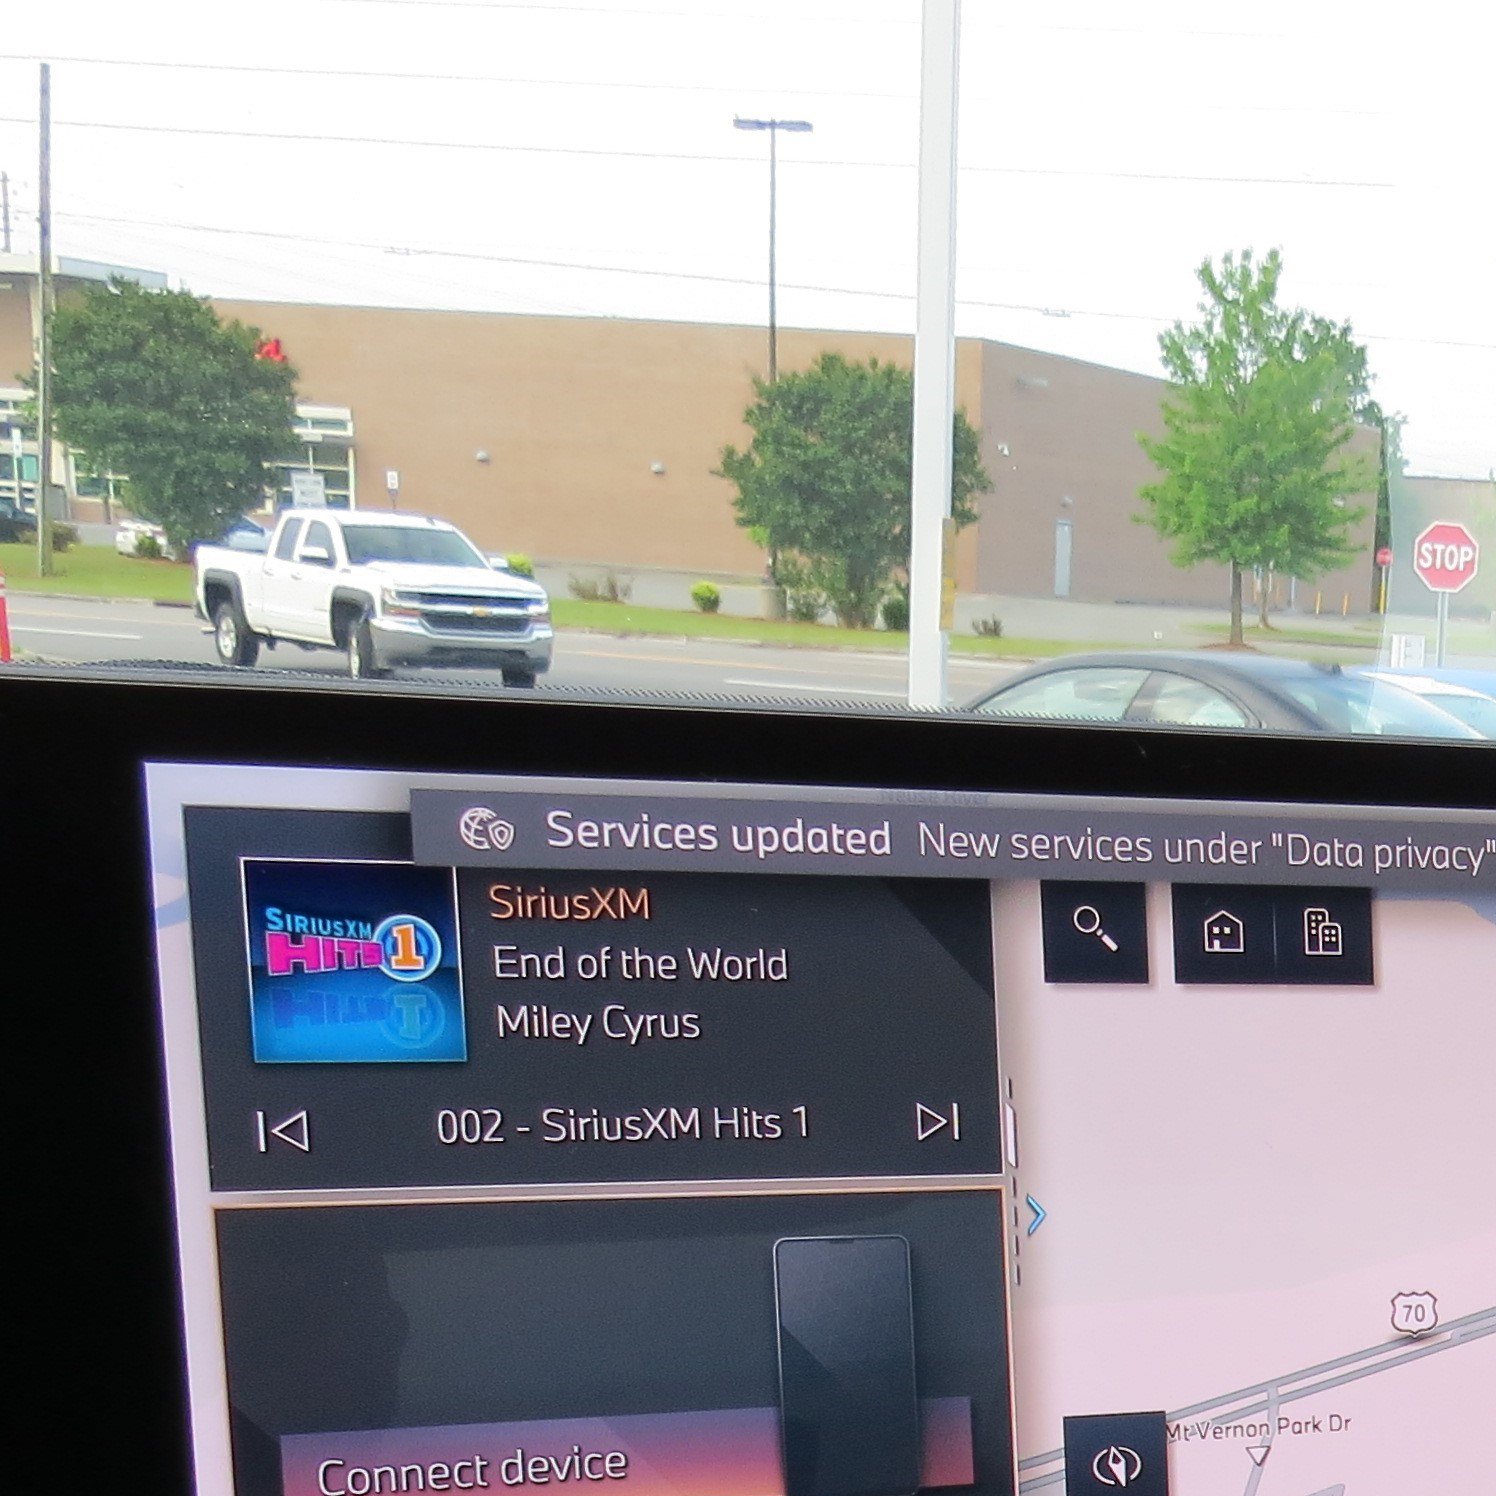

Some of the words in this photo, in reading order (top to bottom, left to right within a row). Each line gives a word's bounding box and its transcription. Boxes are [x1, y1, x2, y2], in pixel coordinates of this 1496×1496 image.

[1419, 542, 1473, 571] STOP
[547, 809, 718, 852] Services
[731, 820, 892, 860] updated
[919, 821, 1000, 860] New
[1010, 826, 1153, 863] services
[1164, 830, 1263, 867] under
[1272, 832, 1365, 868] "Data
[488, 884, 652, 921] SiriusXM
[265, 931, 385, 976] HITS
[391, 923, 425, 971] 1
[493, 944, 565, 980] End
[578, 946, 613, 981] of
[620, 947, 678, 981] the
[686, 948, 789, 982] World
[496, 1004, 593, 1046] Miley
[602, 1004, 701, 1047] Cyrus
[436, 1108, 504, 1145] 002
[541, 1106, 701, 1143] SiriusXM
[712, 1104, 783, 1141] Hits
[793, 1105, 810, 1138] 1
[1402, 1304, 1426, 1323] 70
[1166, 1424, 1190, 1442] Mt
[1196, 1422, 1270, 1440] Vernon
[1277, 1415, 1323, 1436] Park
[1329, 1414, 1352, 1433] Dr
[499, 1444, 629, 1486] device
